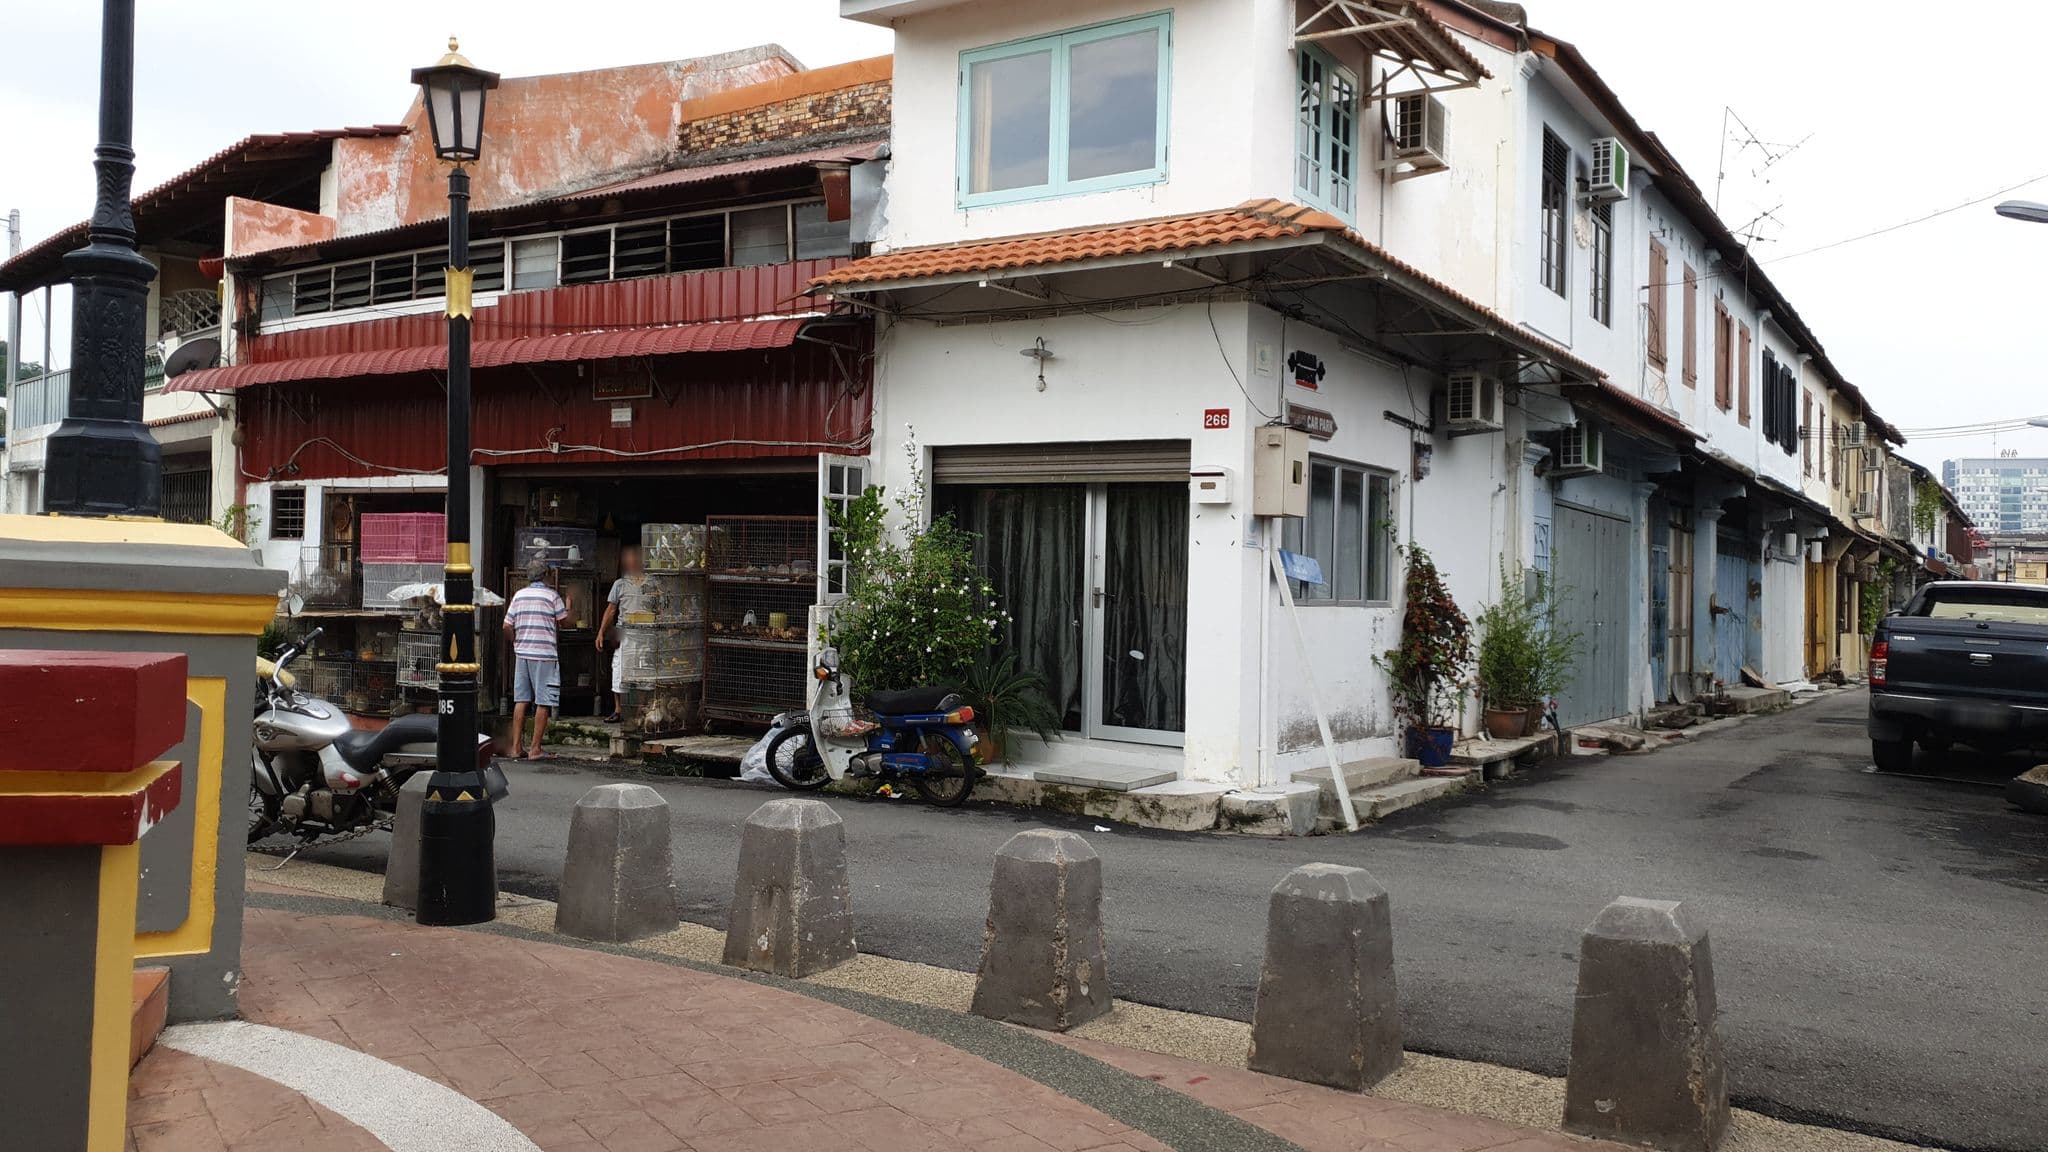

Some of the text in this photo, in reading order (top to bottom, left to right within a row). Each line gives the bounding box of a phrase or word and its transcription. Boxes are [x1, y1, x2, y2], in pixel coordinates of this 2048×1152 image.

[1206, 414, 1228, 426] 266
[1306, 414, 1318, 430] CAR
[1319, 416, 1333, 433] PARK
